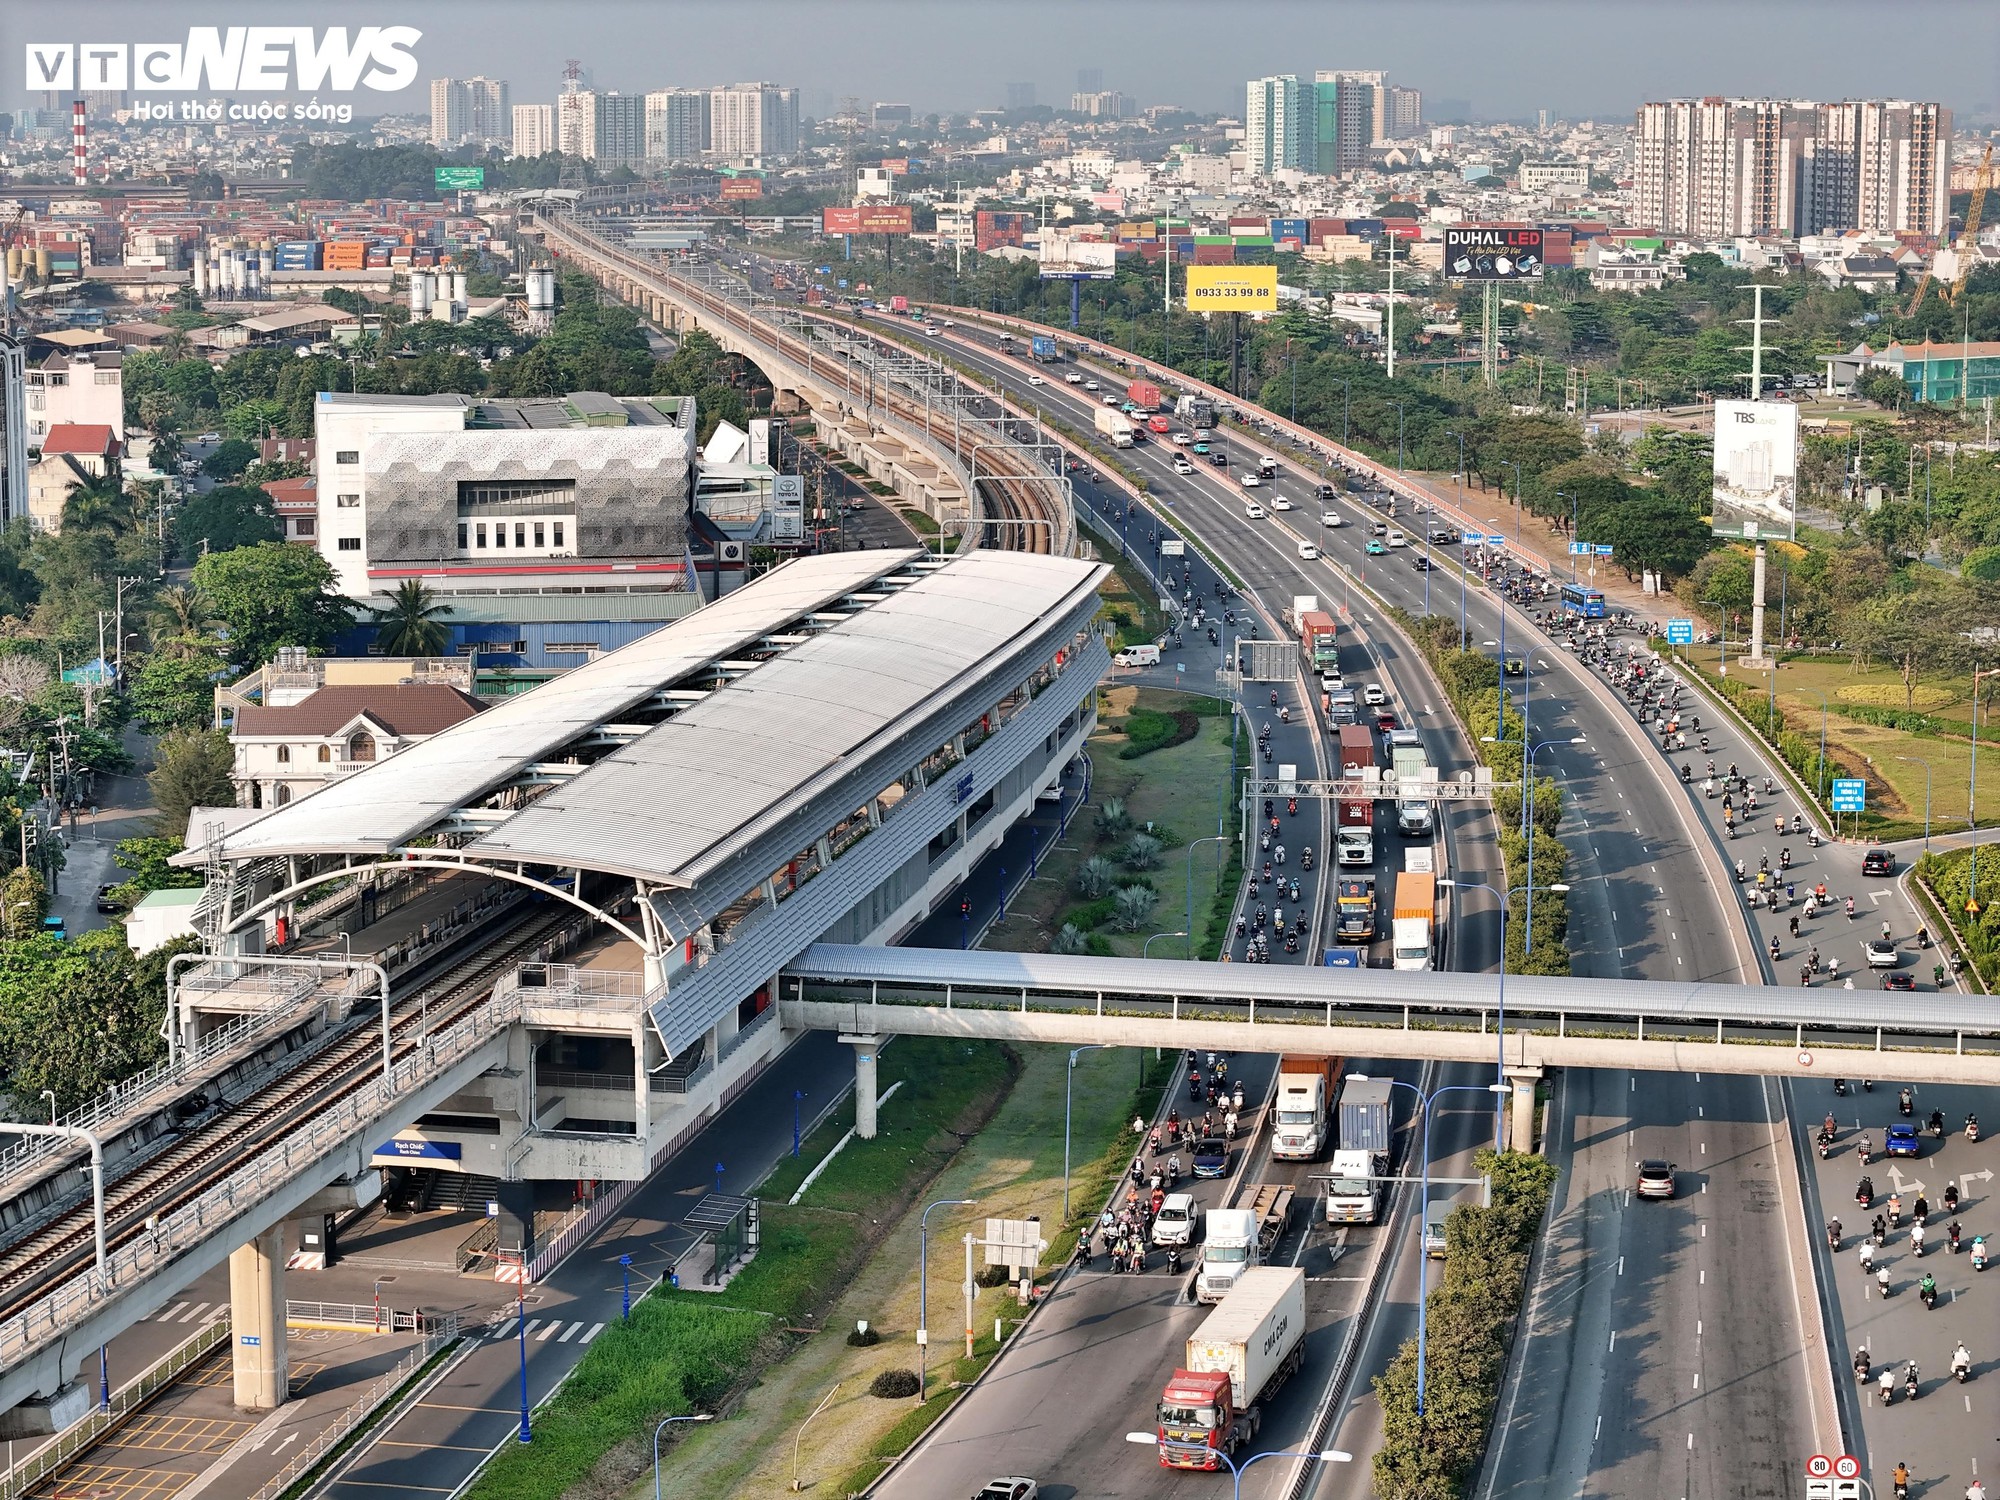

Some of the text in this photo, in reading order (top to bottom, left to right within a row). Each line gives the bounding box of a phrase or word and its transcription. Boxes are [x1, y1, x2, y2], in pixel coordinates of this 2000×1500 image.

[1449, 231, 1540, 245] DUHAL LED
[1734, 412, 1755, 424] TBS
[1814, 1461, 1825, 1471] 80
[1841, 1462, 1853, 1472] 60
